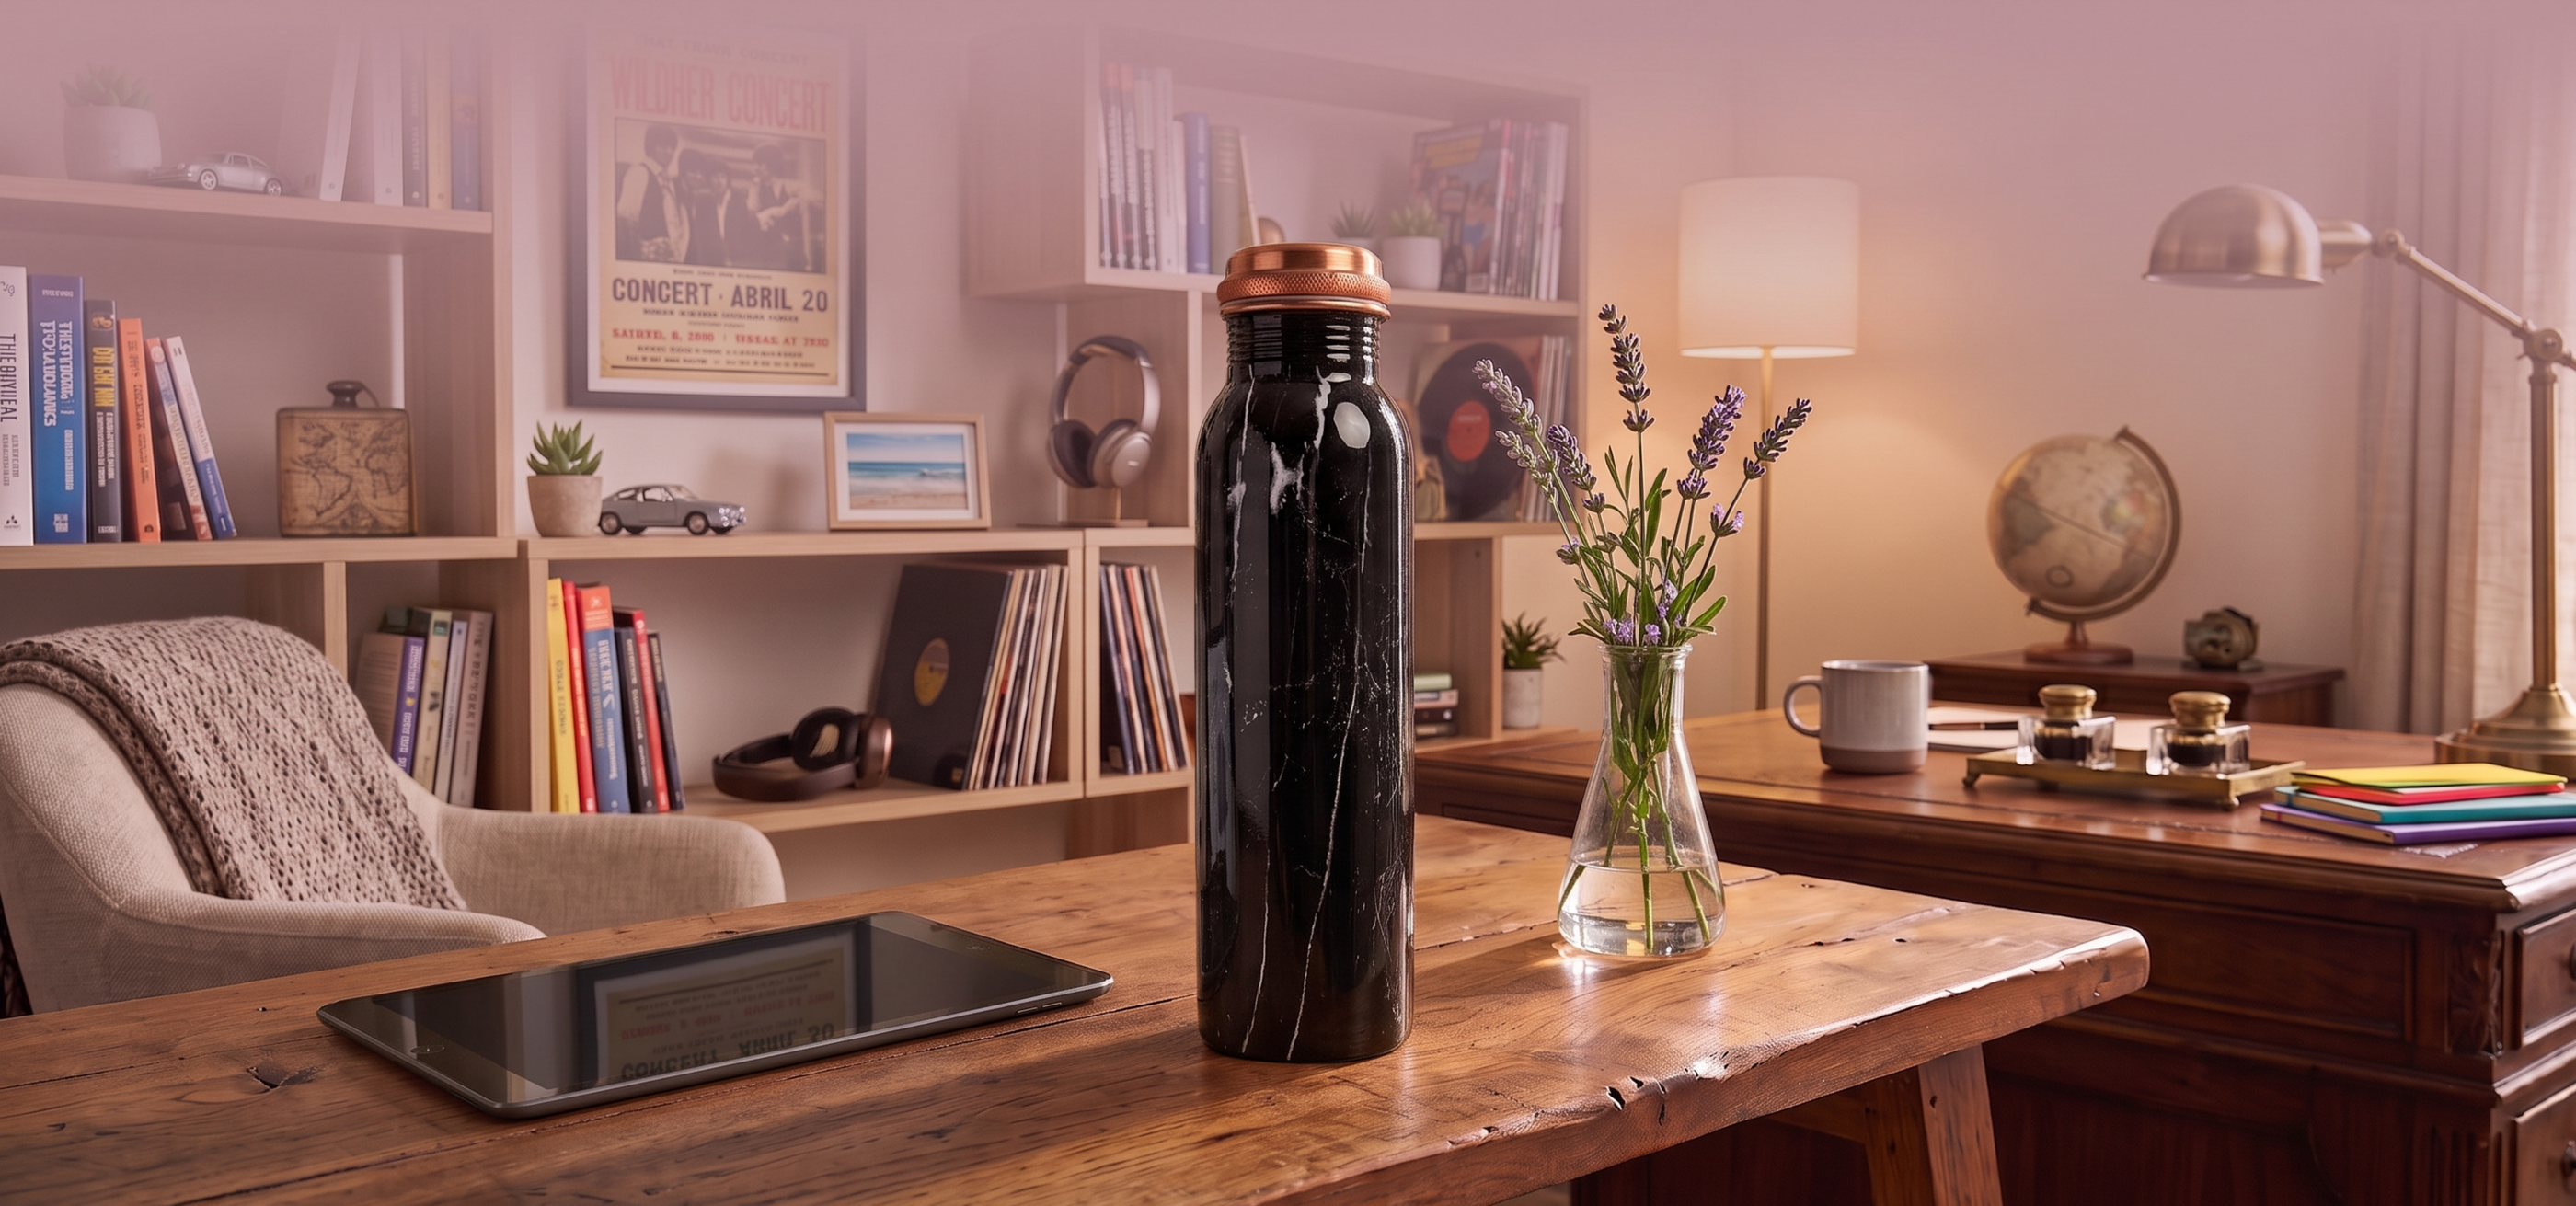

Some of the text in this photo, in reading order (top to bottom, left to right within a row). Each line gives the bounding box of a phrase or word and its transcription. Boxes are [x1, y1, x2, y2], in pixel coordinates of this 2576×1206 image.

[610, 54, 832, 133] WILDHER CONCERT
[612, 278, 829, 313] CONCERT ABRIL 20
